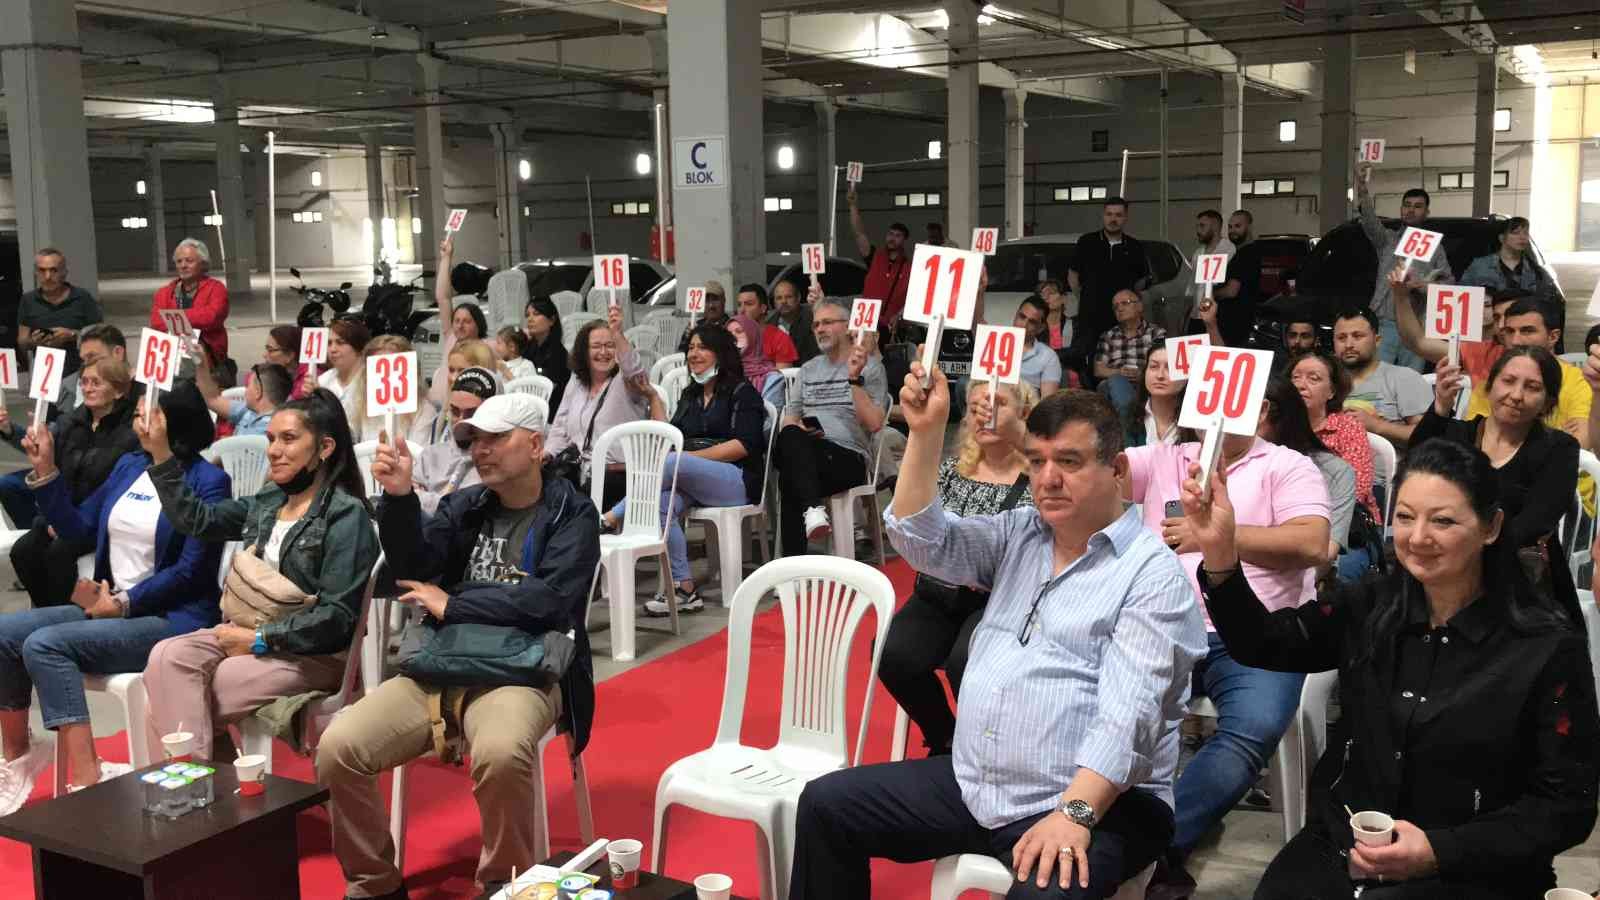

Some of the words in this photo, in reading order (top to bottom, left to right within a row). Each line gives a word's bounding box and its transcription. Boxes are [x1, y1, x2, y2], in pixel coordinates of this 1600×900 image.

[691, 142, 707, 170] C
[686, 172, 714, 185] BLOK
[976, 230, 993, 252] 48
[1403, 231, 1432, 258] 65
[601, 258, 625, 288] 16
[807, 248, 822, 272] 15
[1202, 256, 1223, 281] 17
[688, 289, 703, 310] 32
[922, 254, 966, 321] 11
[854, 303, 876, 328] 34
[1435, 290, 1470, 337] 51
[143, 336, 172, 384] 63
[304, 333, 323, 359] 41
[979, 331, 1017, 379] 49
[1174, 338, 1202, 376] 4
[40, 353, 55, 396] 2
[375, 356, 409, 406] 33
[1195, 350, 1257, 420] 50
